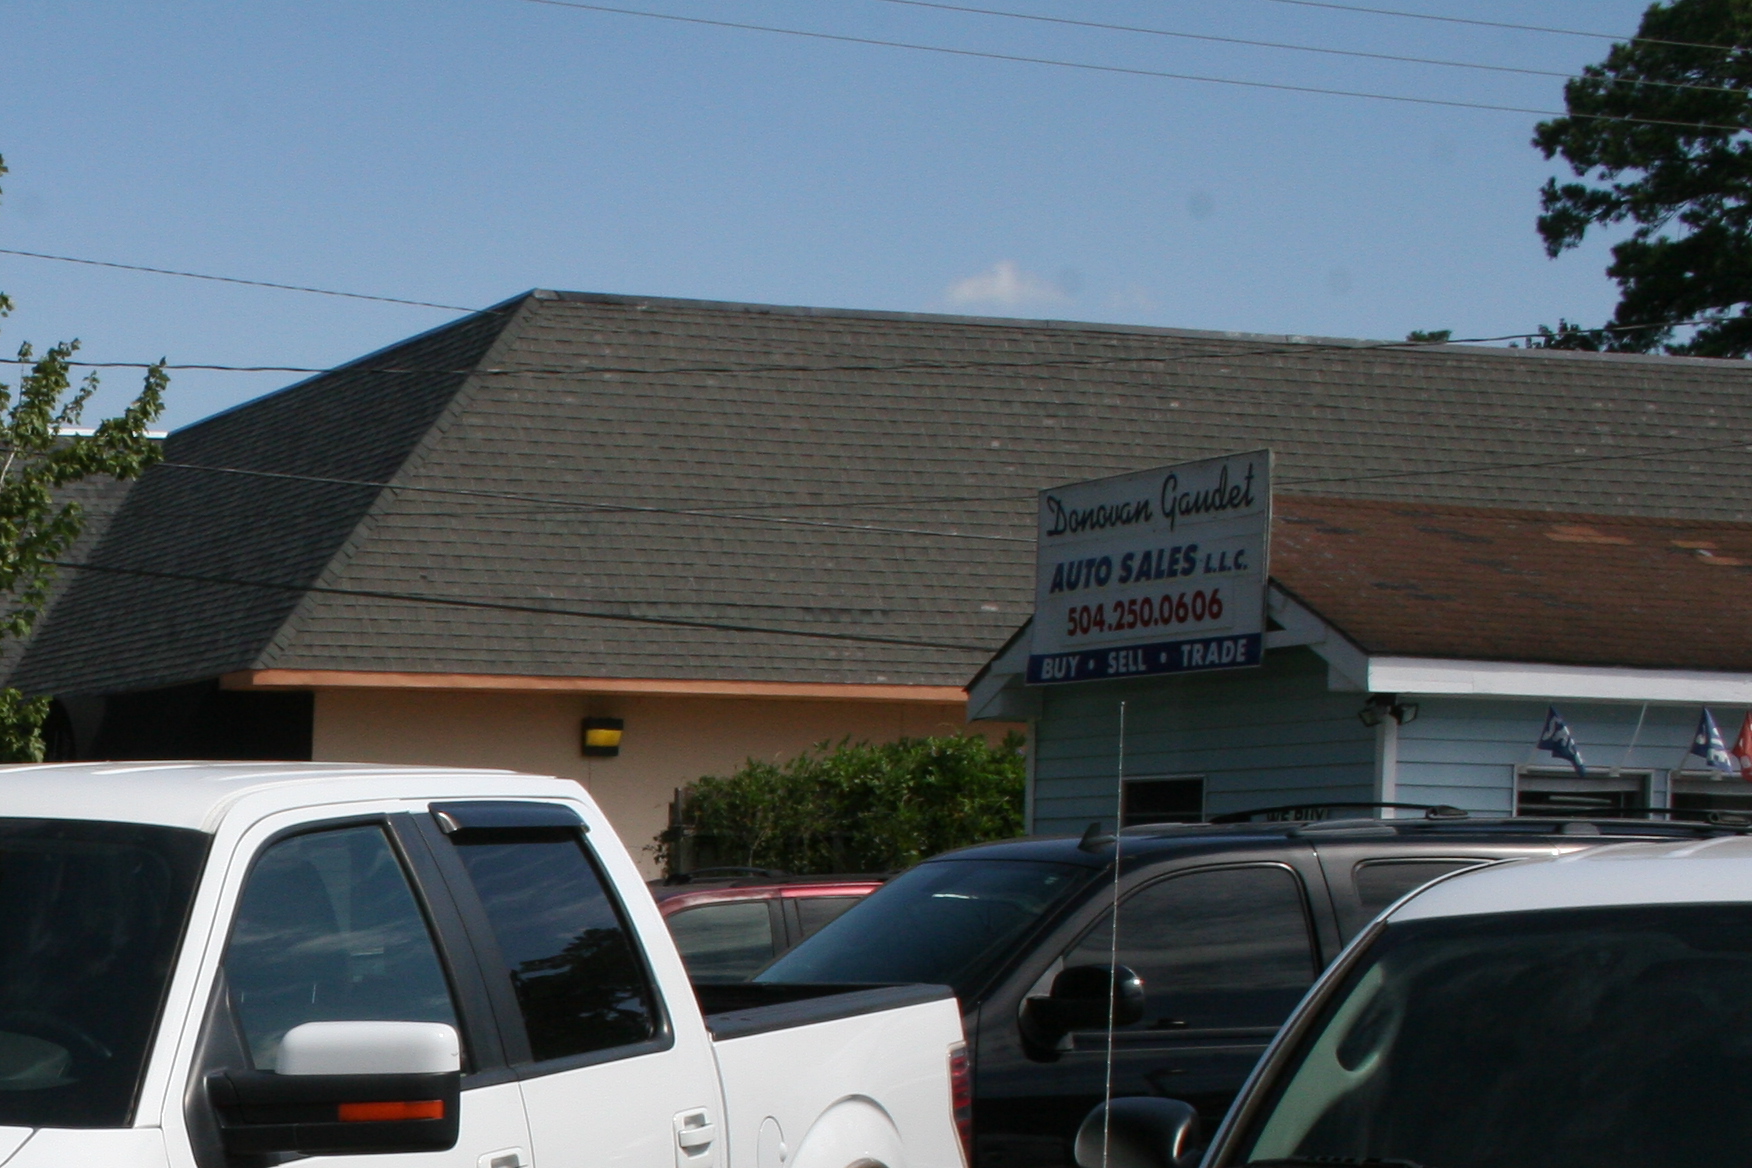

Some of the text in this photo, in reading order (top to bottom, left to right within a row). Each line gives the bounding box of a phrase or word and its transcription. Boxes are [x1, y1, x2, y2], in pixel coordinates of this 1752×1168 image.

[1046, 462, 1255, 536] Donovan Gaudet
[1049, 544, 1248, 593] AUTO SALES L.L.C.
[1067, 588, 1224, 636] 504.250.0606
[1040, 638, 1248, 680] BUY SELL TRADE
